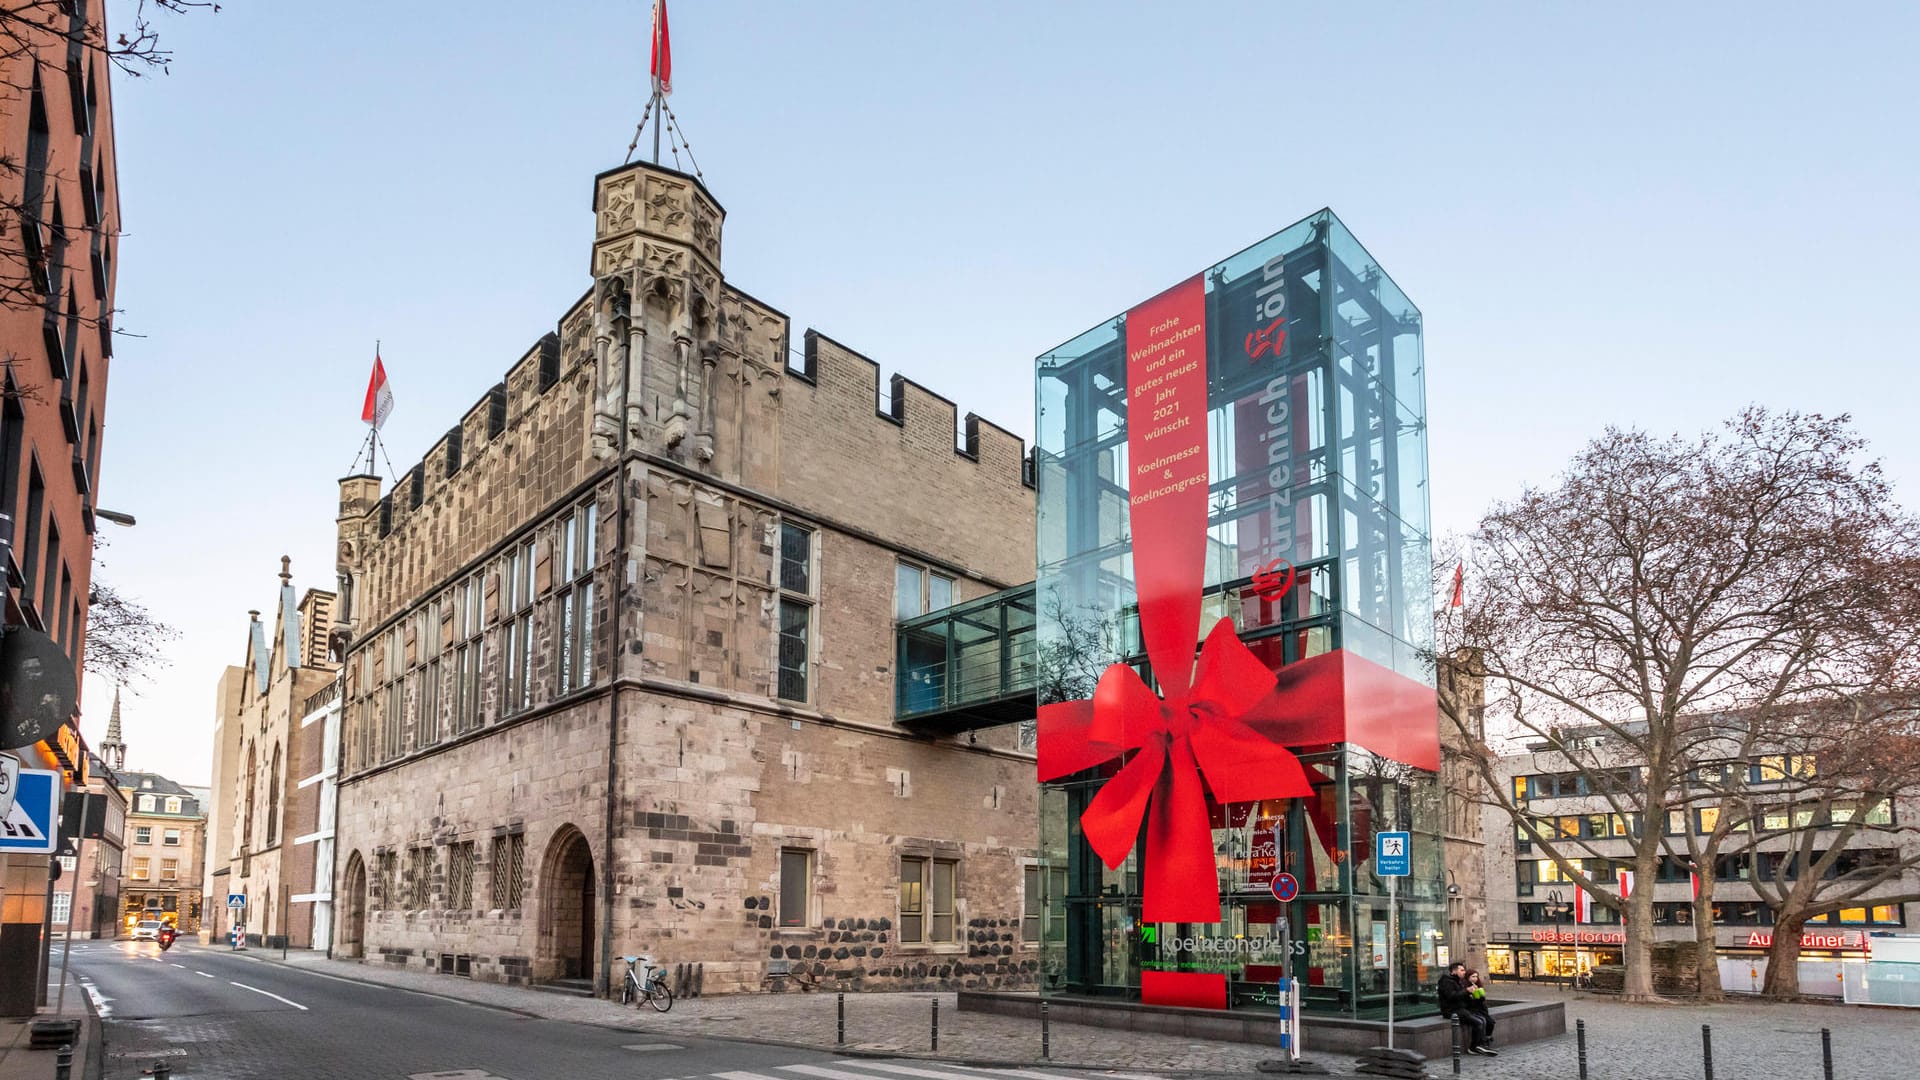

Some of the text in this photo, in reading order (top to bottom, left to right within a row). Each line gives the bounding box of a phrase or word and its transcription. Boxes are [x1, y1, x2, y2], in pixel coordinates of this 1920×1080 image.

[1150, 315, 1180, 337] Frohe
[1131, 323, 1201, 363] Weihnachten
[1145, 348, 1185, 373] und ein
[1134, 359, 1198, 398] gutes neues
[1154, 385, 1177, 406] Jahr
[1152, 401, 1180, 421] 2021
[1144, 415, 1191, 441] wünscht
[1137, 444, 1201, 476] Koelnmesse
[1163, 468, 1173, 480] &
[1130, 471, 1207, 507] Koelncongress
[1748, 932, 1846, 947] Autiner
